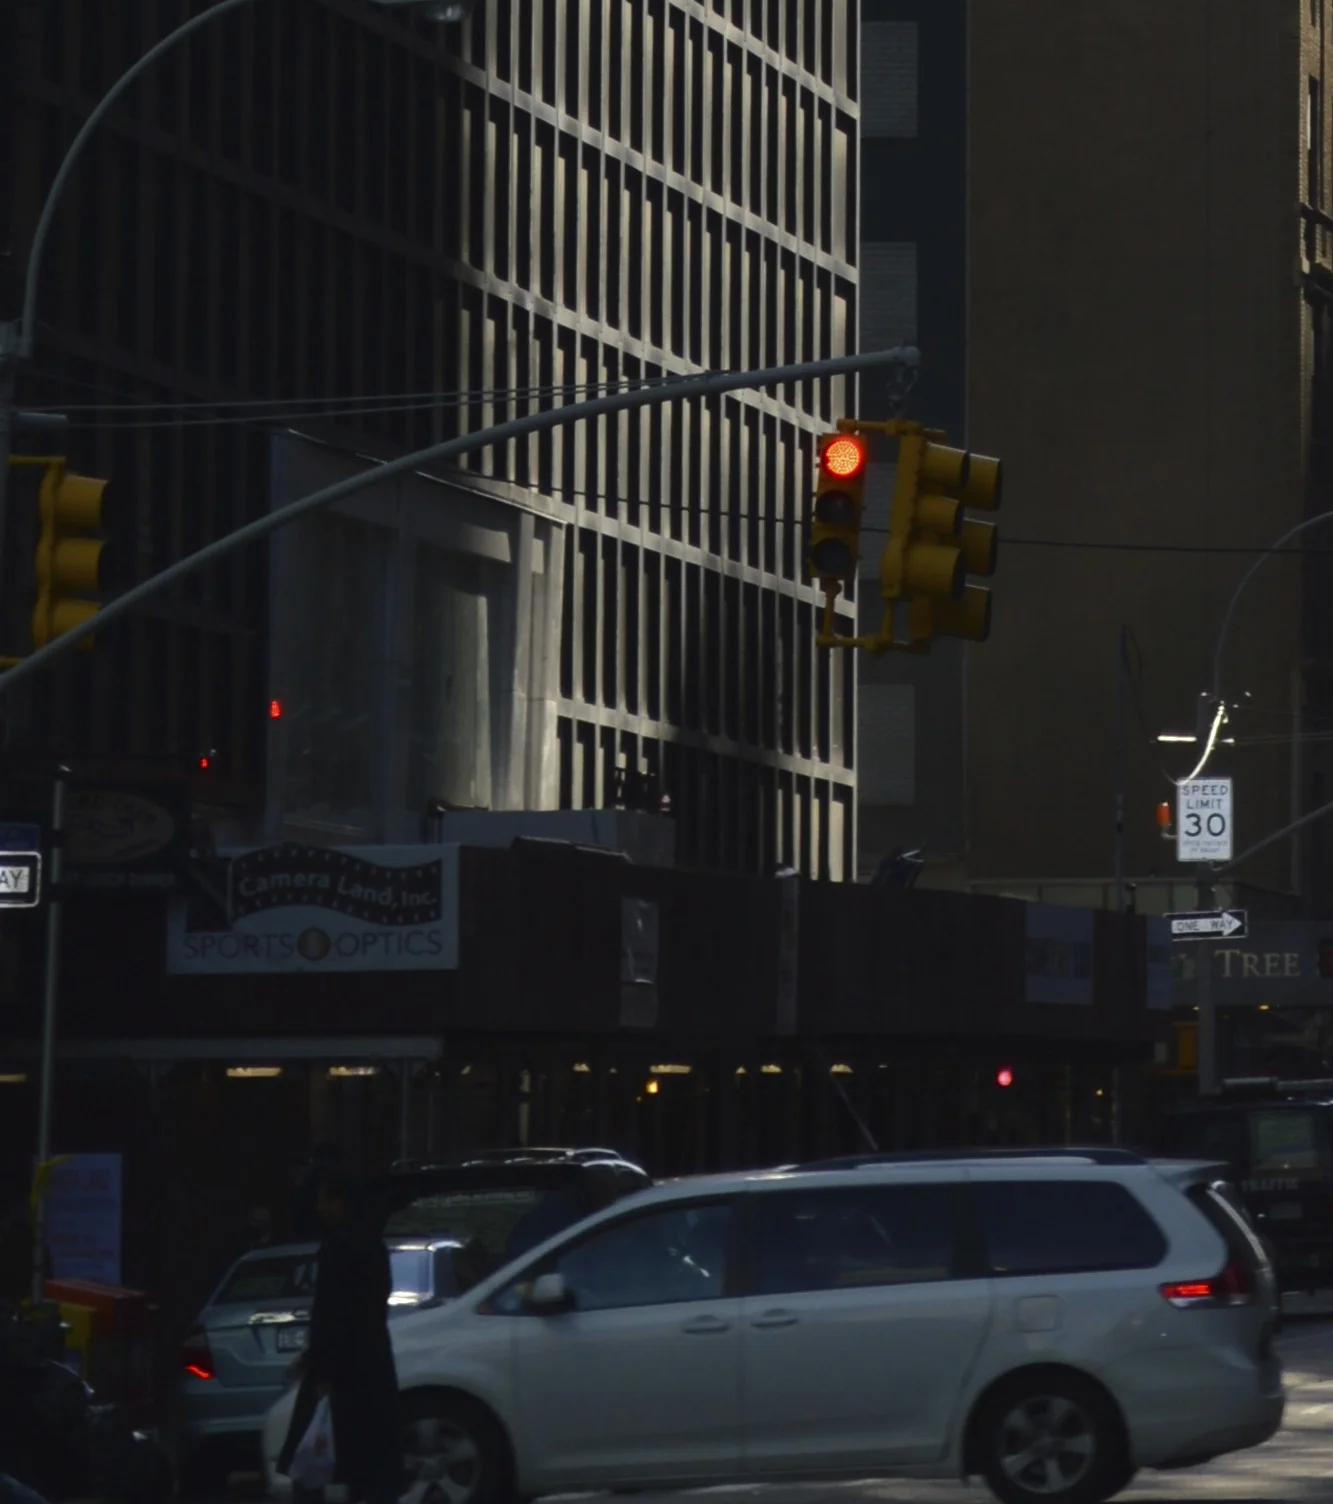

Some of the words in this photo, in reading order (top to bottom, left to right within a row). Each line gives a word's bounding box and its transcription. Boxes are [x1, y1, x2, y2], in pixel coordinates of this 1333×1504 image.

[1181, 784, 1229, 796] SPEED
[1187, 798, 1222, 810] LIMIT
[1184, 813, 1226, 837] 30
[237, 871, 330, 898] Camera
[337, 874, 399, 911] Land,
[402, 890, 438, 906] Inc.
[1177, 920, 1200, 932] ONE
[1209, 918, 1233, 930] WAY
[184, 933, 293, 960] SPORTS
[336, 929, 444, 957] OPTICS
